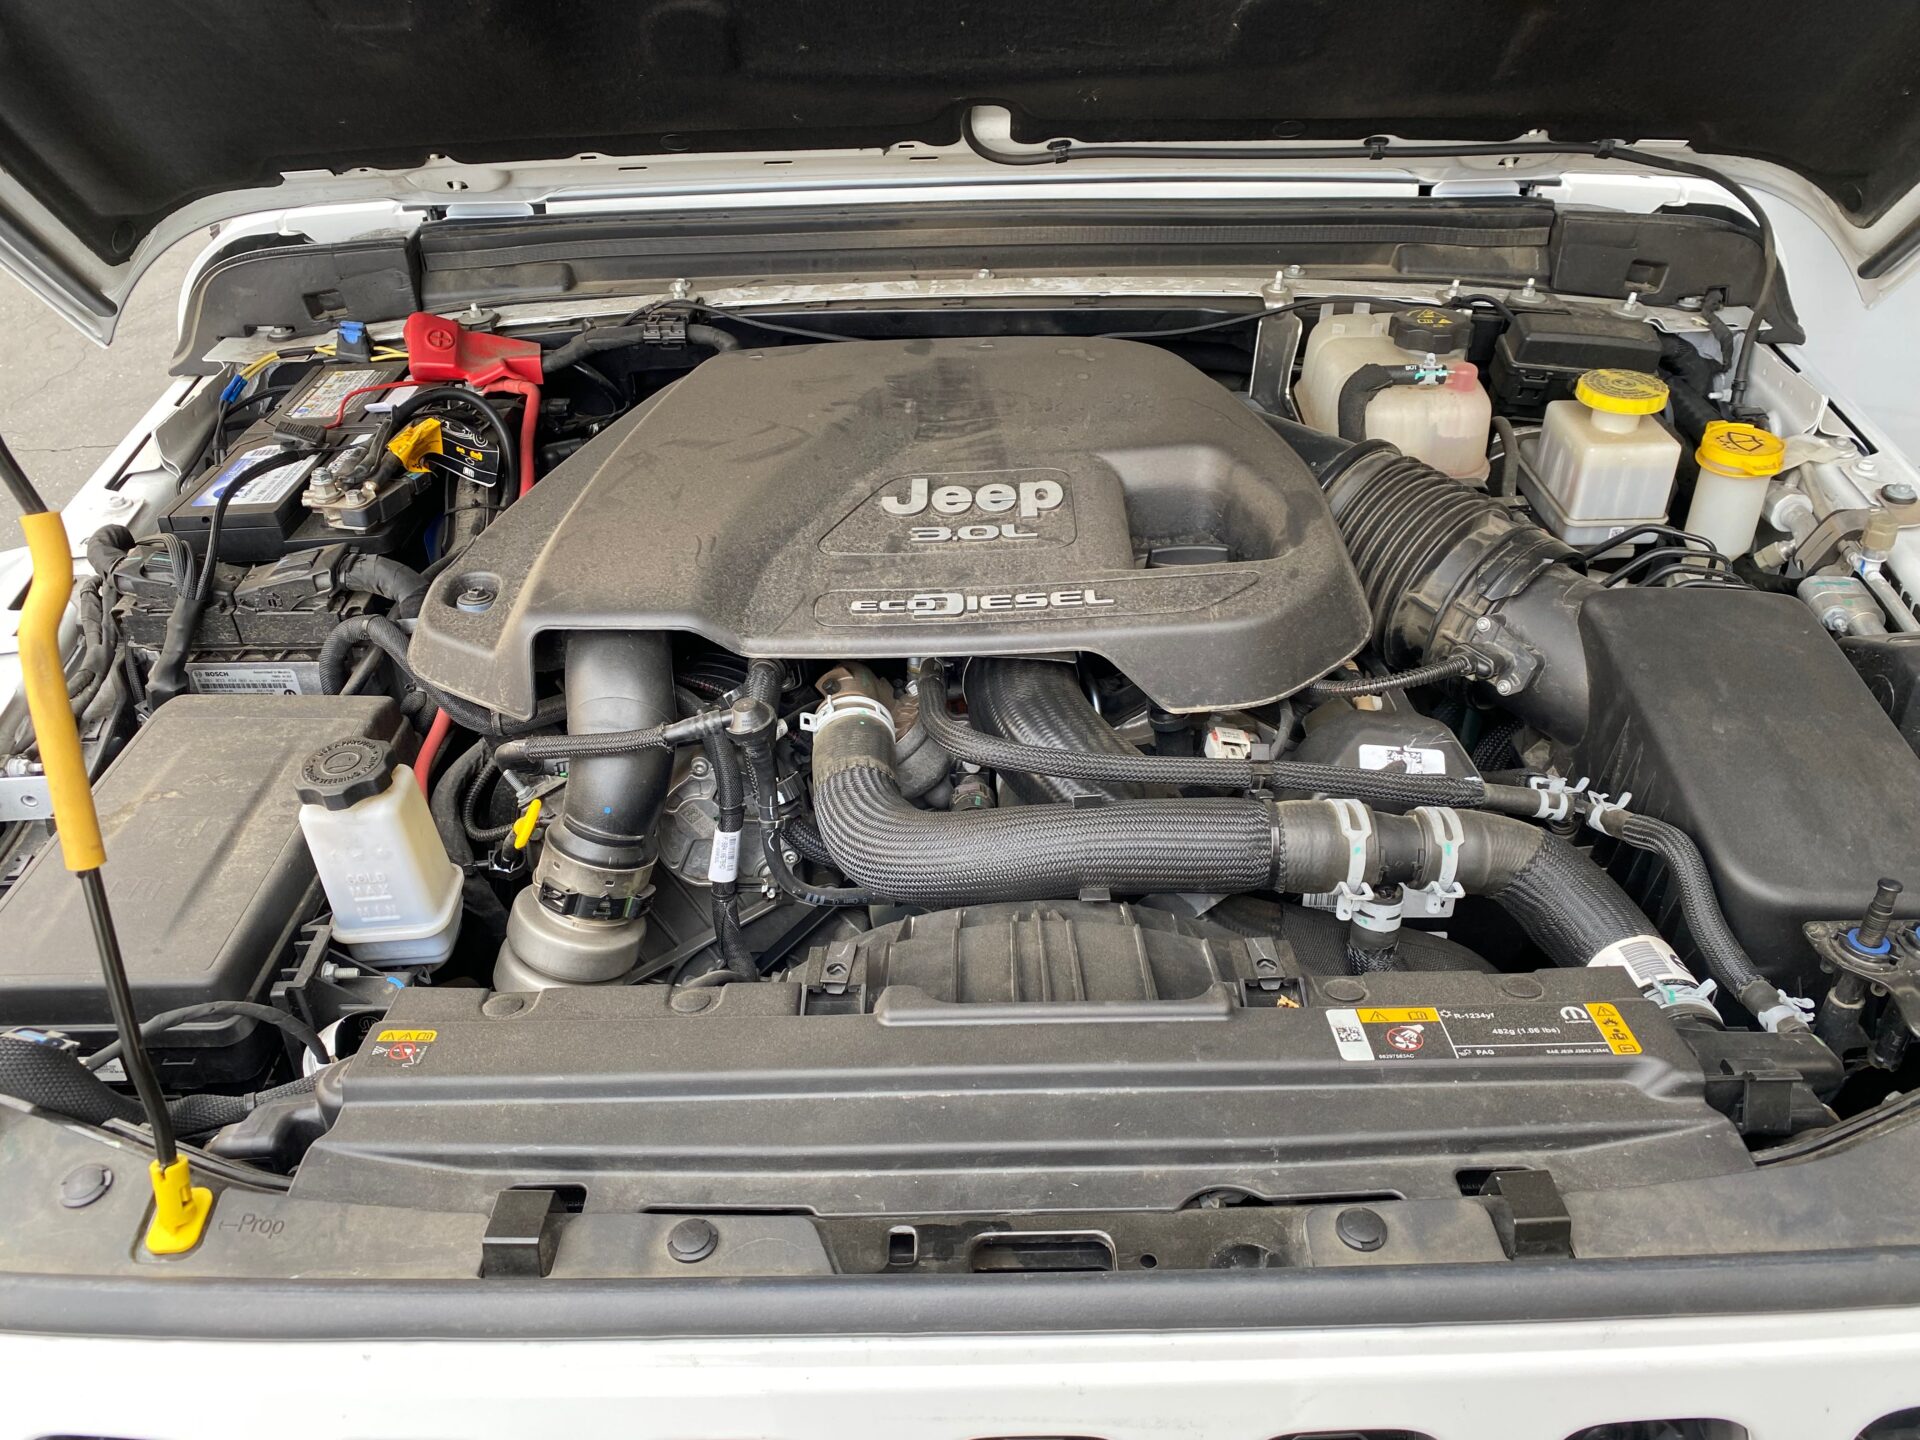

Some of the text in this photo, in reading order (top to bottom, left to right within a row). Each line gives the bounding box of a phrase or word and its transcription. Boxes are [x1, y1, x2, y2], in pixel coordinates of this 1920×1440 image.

[881, 477, 1064, 518] Jeep
[909, 523, 1039, 543] 3.0L
[1454, 1012, 1495, 1020] R-1234yf
[1492, 1027, 1516, 1036] 482g
[236, 1212, 286, 1240] Prop
